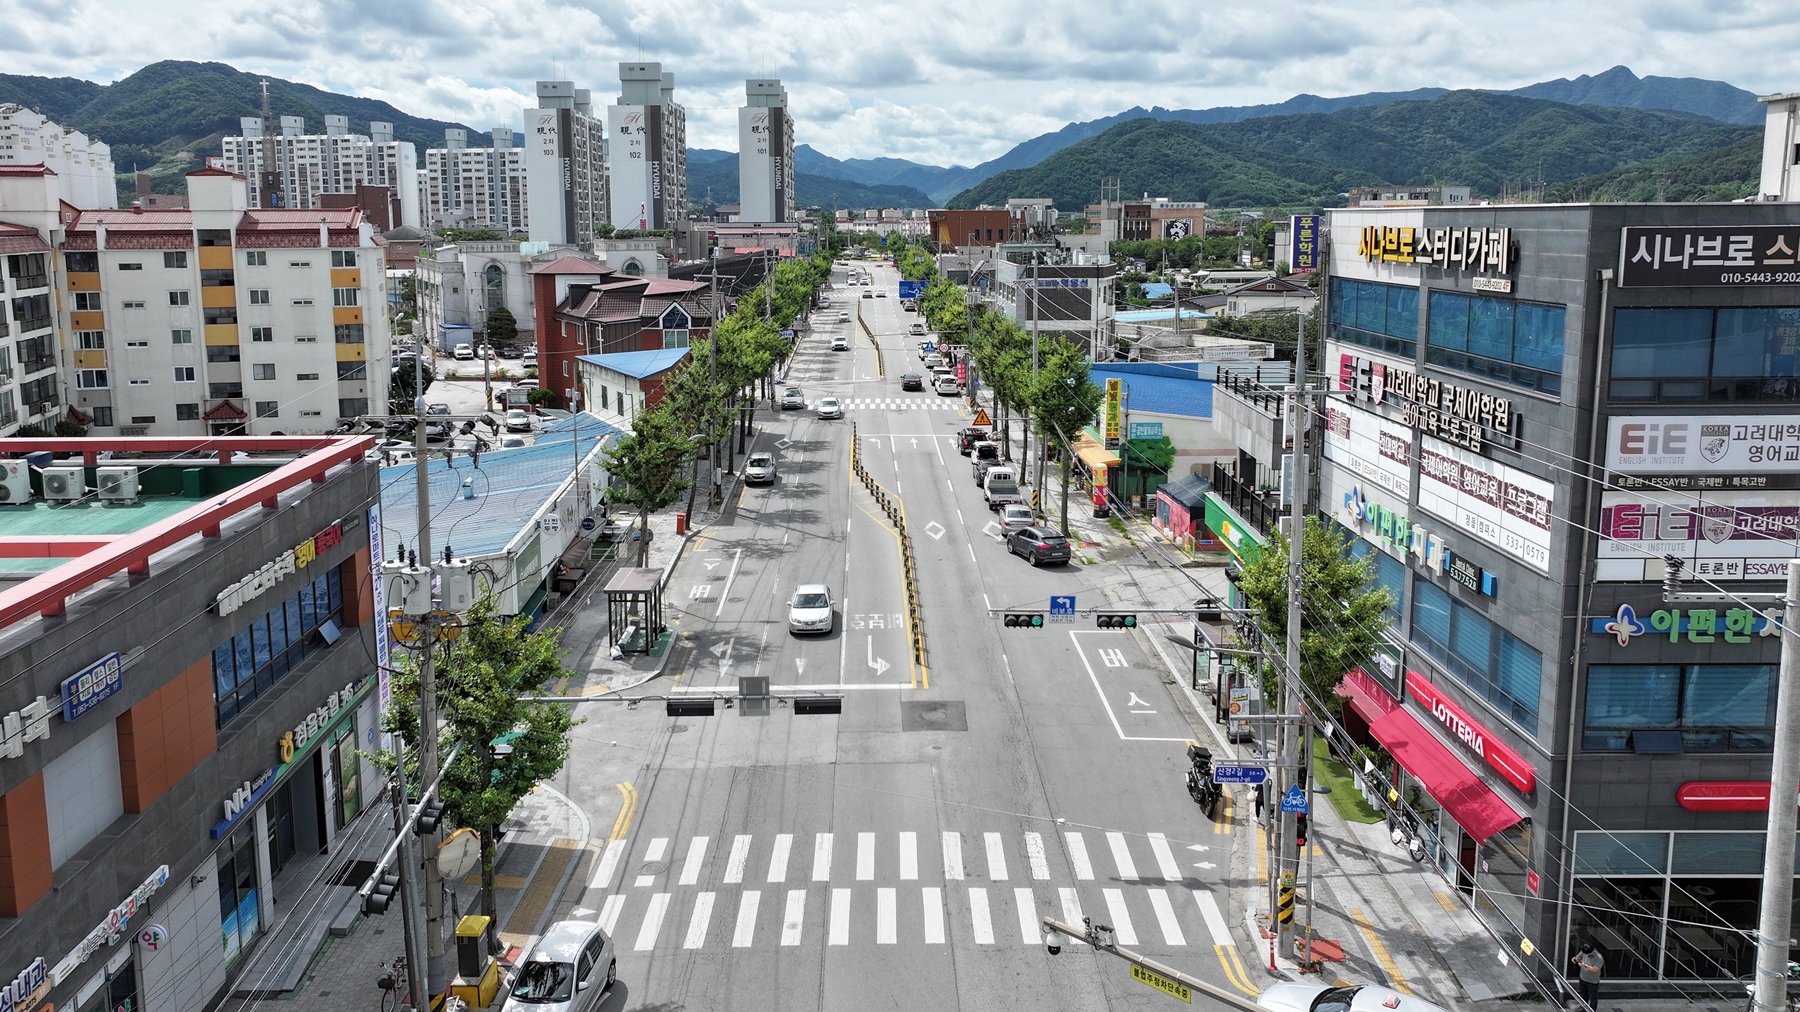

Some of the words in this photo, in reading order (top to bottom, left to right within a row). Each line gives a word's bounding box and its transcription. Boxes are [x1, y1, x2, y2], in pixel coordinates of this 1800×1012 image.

[629, 151, 641, 159] 102
[563, 157, 571, 191] HYUNDAI
[653, 161, 661, 199] HYUNDAI
[1298, 217, 1314, 267] 푸른학원
[1358, 225, 1415, 264] 시나브로
[1416, 226, 1511, 275] 스터디카페
[1630, 233, 1755, 270] 시나브로
[1762, 234, 1800, 266] 스
[1720, 272, 1800, 283] 010-5443-9202
[1386, 367, 1441, 408] 고려대학교
[1442, 383, 1511, 433] 국제어학원
[1402, 401, 1439, 436] 영어교육
[1439, 412, 1482, 454] 프로그램
[1620, 424, 1688, 454] EiE
[1619, 456, 1647, 465] ENGLISH
[1651, 456, 1685, 465] INSTITUTE
[1651, 477, 1689, 487] ESSAY반
[1697, 477, 1723, 487] 국제반
[1731, 477, 1767, 487] 특목고반
[1465, 513, 1476, 530] 정읍
[1505, 533, 1545, 563] 533-0579
[1611, 503, 1690, 540] EiE
[1611, 543, 1642, 552] ENGLISH
[1647, 542, 1686, 552] INSTITUTE
[1700, 562, 1739, 576] 토론반
[1051, 607, 1074, 615] 비보호
[113, 682, 120, 692] 1F
[294, 692, 339, 748] 정읍농협
[1432, 697, 1485, 758] LOTTERIA
[1217, 767, 1243, 777] 신경2길
[224, 780, 252, 821] NH
[141, 931, 160, 950] 약
[1133, 967, 1188, 999] 불법주정차단속중
